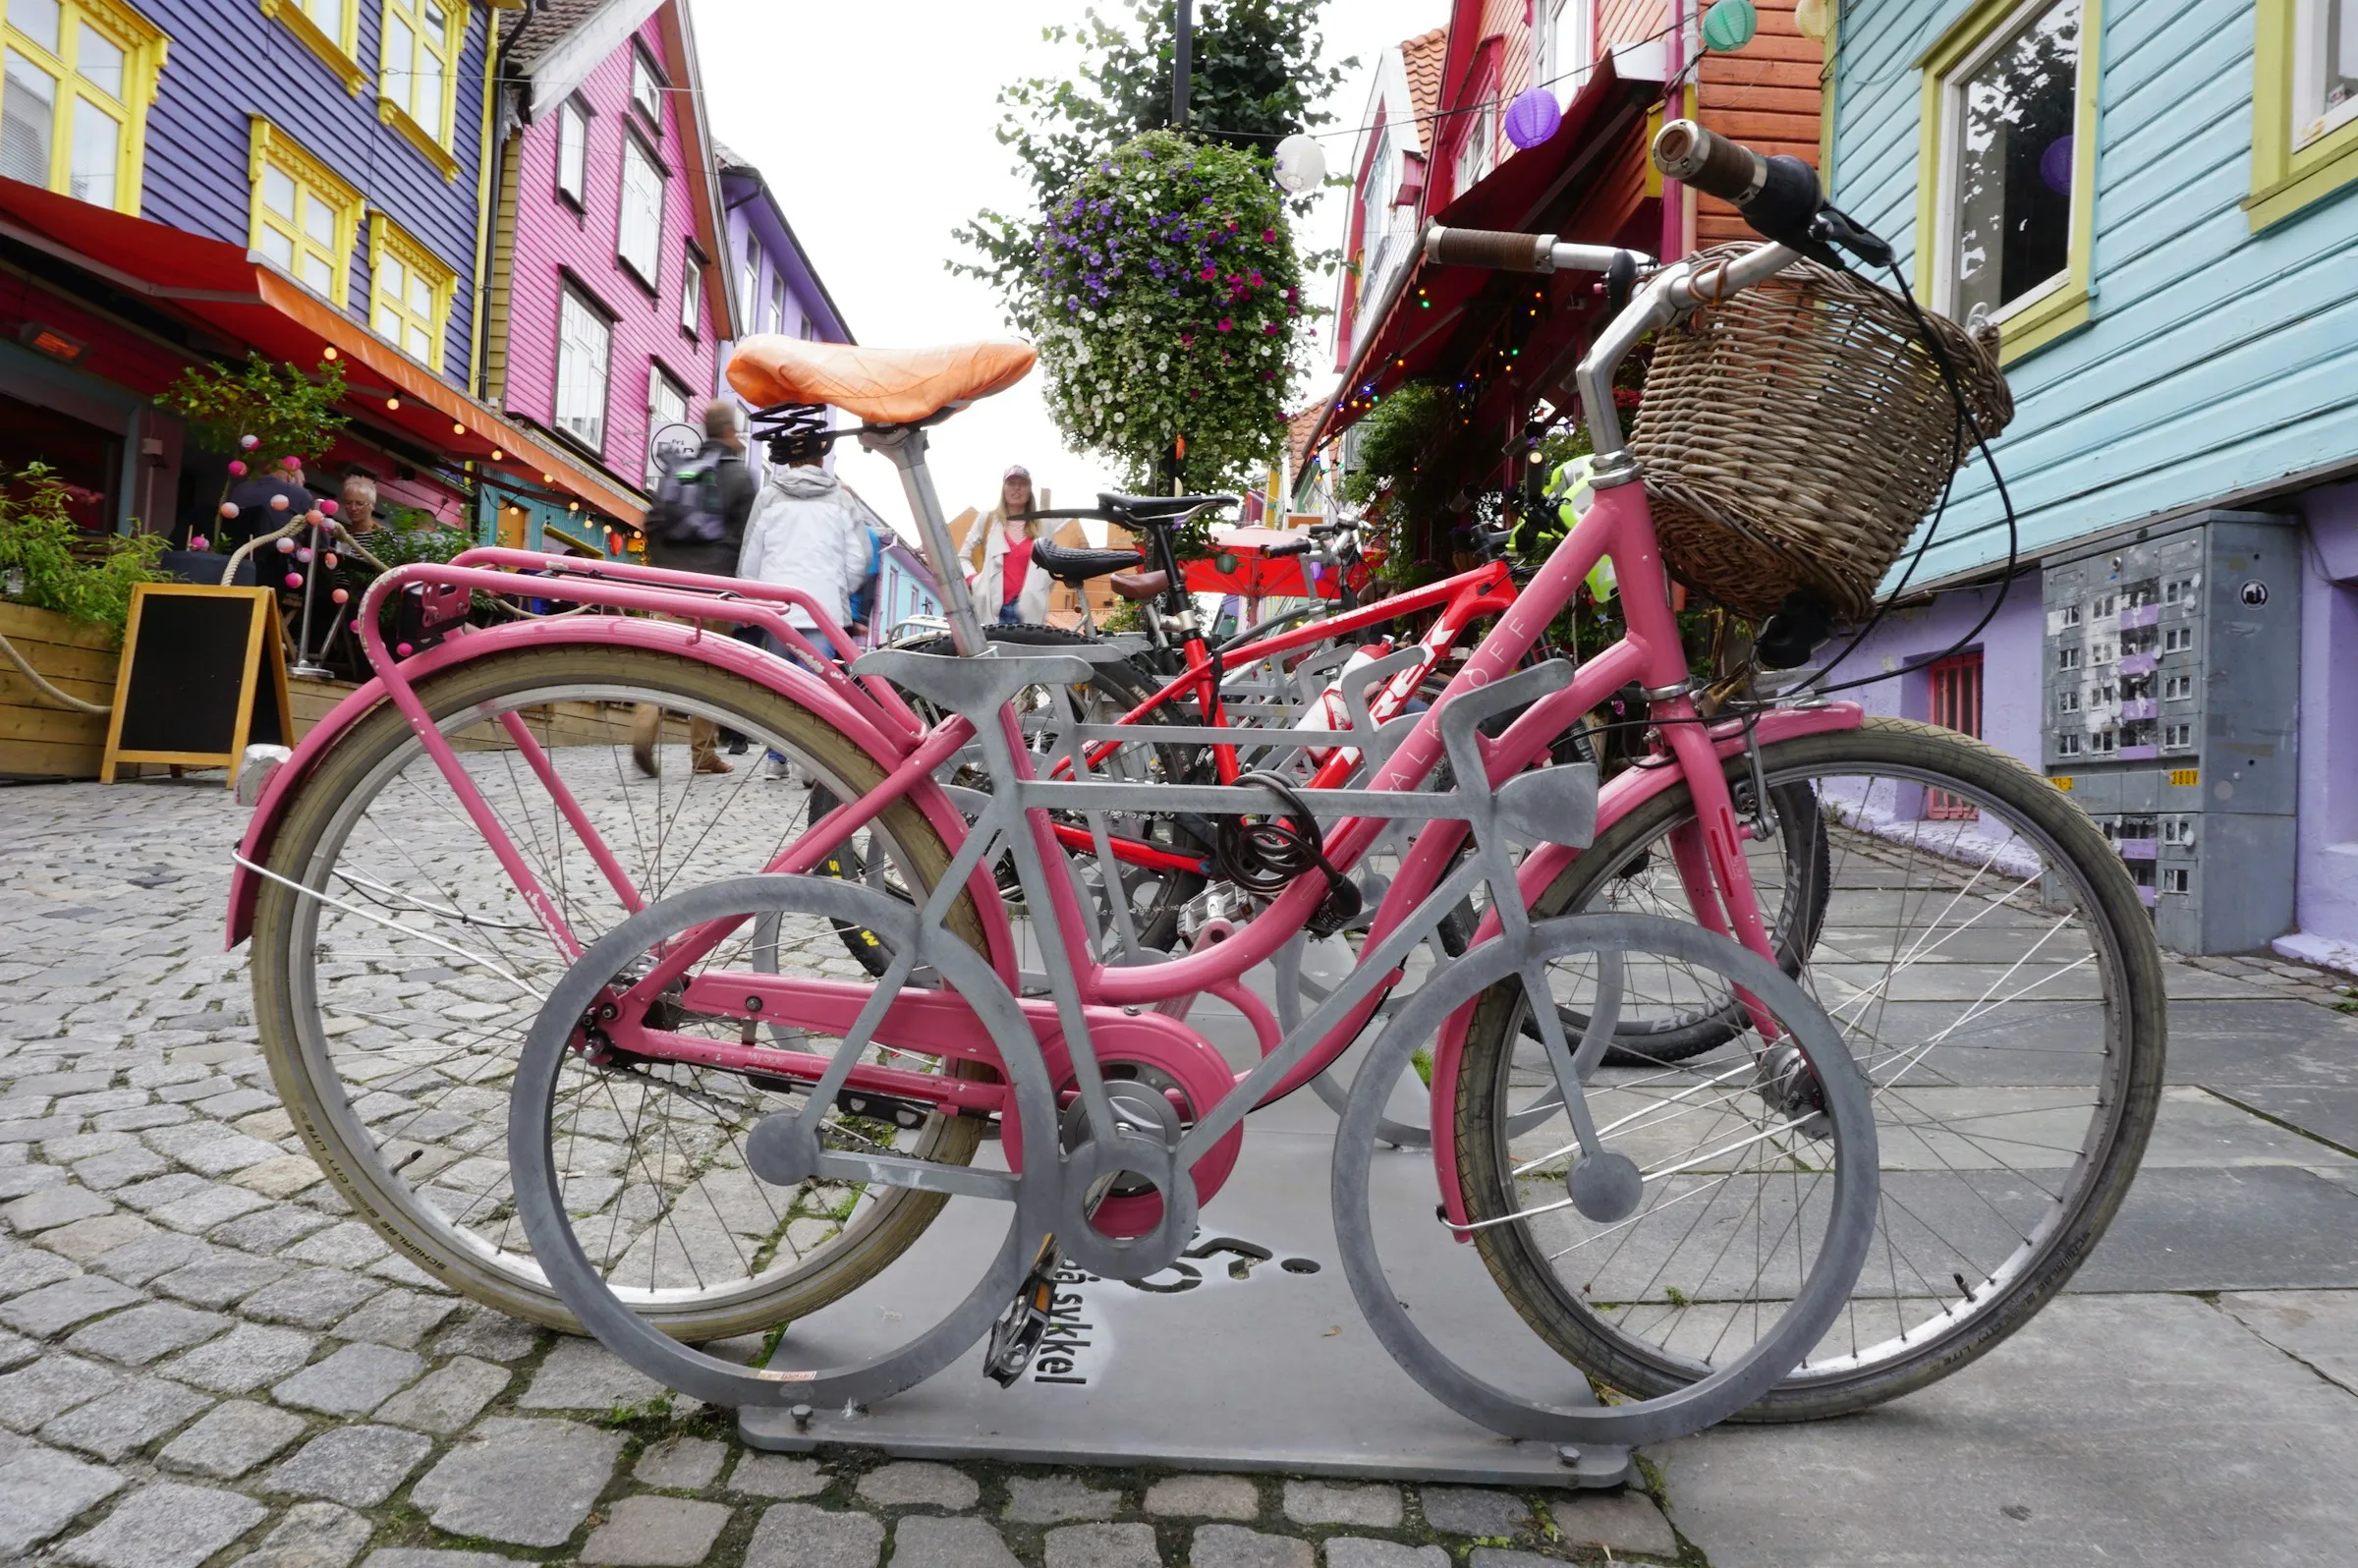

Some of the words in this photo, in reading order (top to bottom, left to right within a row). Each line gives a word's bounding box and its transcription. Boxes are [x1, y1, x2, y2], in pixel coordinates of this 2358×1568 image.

[1387, 617, 1526, 793] ALKOFF
[2171, 770, 2199, 786] 380V
[305, 1123, 327, 1152] LITE
[324, 1157, 350, 1184] CITY
[379, 1220, 448, 1271] SCHWALBE
[1034, 1293, 1094, 1385] sykkel
